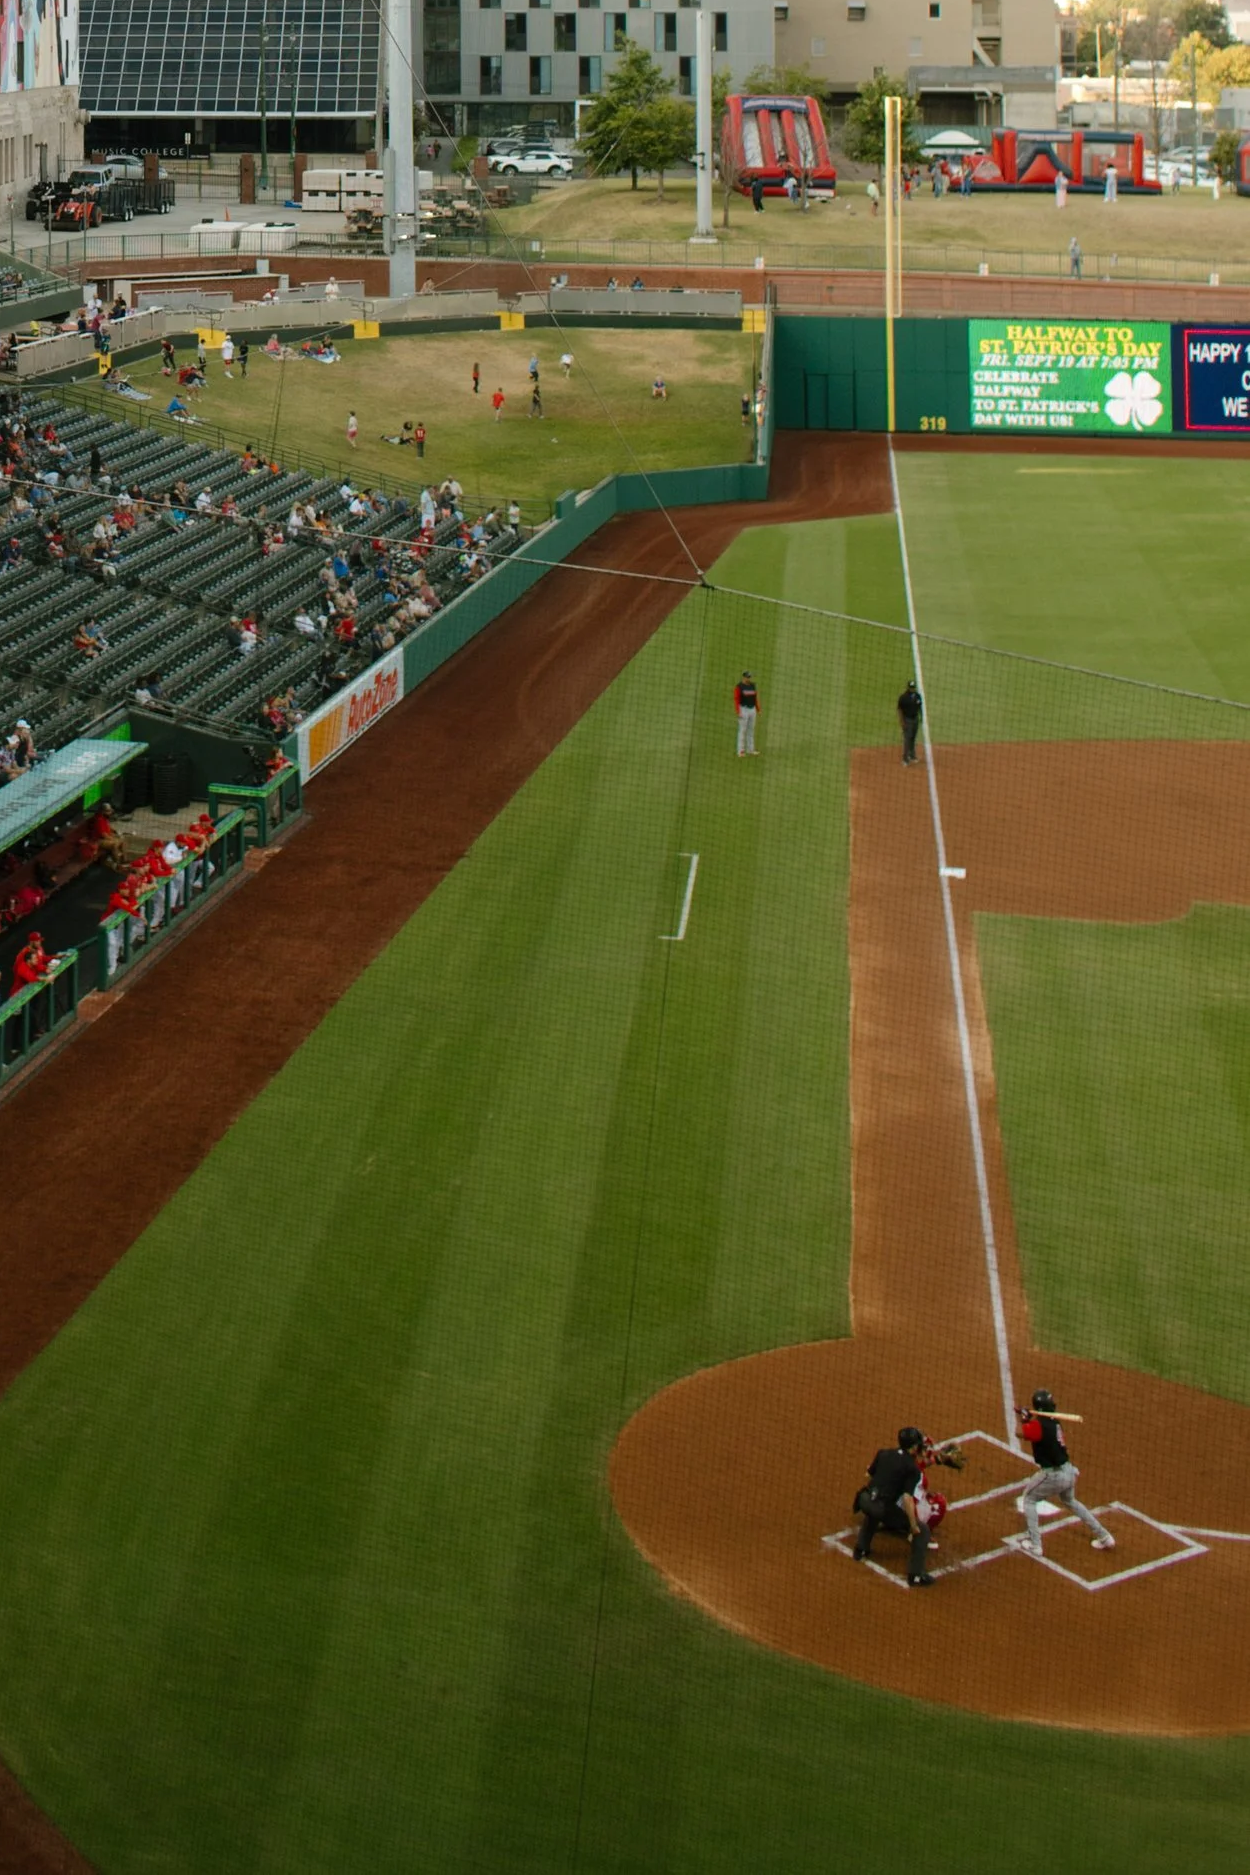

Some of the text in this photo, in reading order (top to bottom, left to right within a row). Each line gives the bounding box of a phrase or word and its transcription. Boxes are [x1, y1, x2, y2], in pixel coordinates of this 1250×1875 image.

[91, 148, 128, 156] MUSIC
[132, 147, 185, 157] COLLEGE
[1007, 326, 1134, 342] HALFWAY TO
[979, 339, 1163, 356] ST. PATRICK'S DAY
[1189, 342, 1242, 363] HAPPY
[980, 354, 1011, 366] FRI.
[1014, 355, 1056, 367] SEPT
[1076, 356, 1100, 368] AT
[1132, 356, 1160, 369] PM
[973, 371, 1060, 383] CELEBRATE
[973, 385, 1041, 397] HALFWAY
[974, 399, 1100, 413] TO ST. PATRICK'S
[1222, 396, 1249, 418] WE
[920, 416, 946, 430] 319
[974, 413, 1002, 425] DAY
[1005, 414, 1047, 426] WITH
[347, 667, 399, 738] AutoZone
